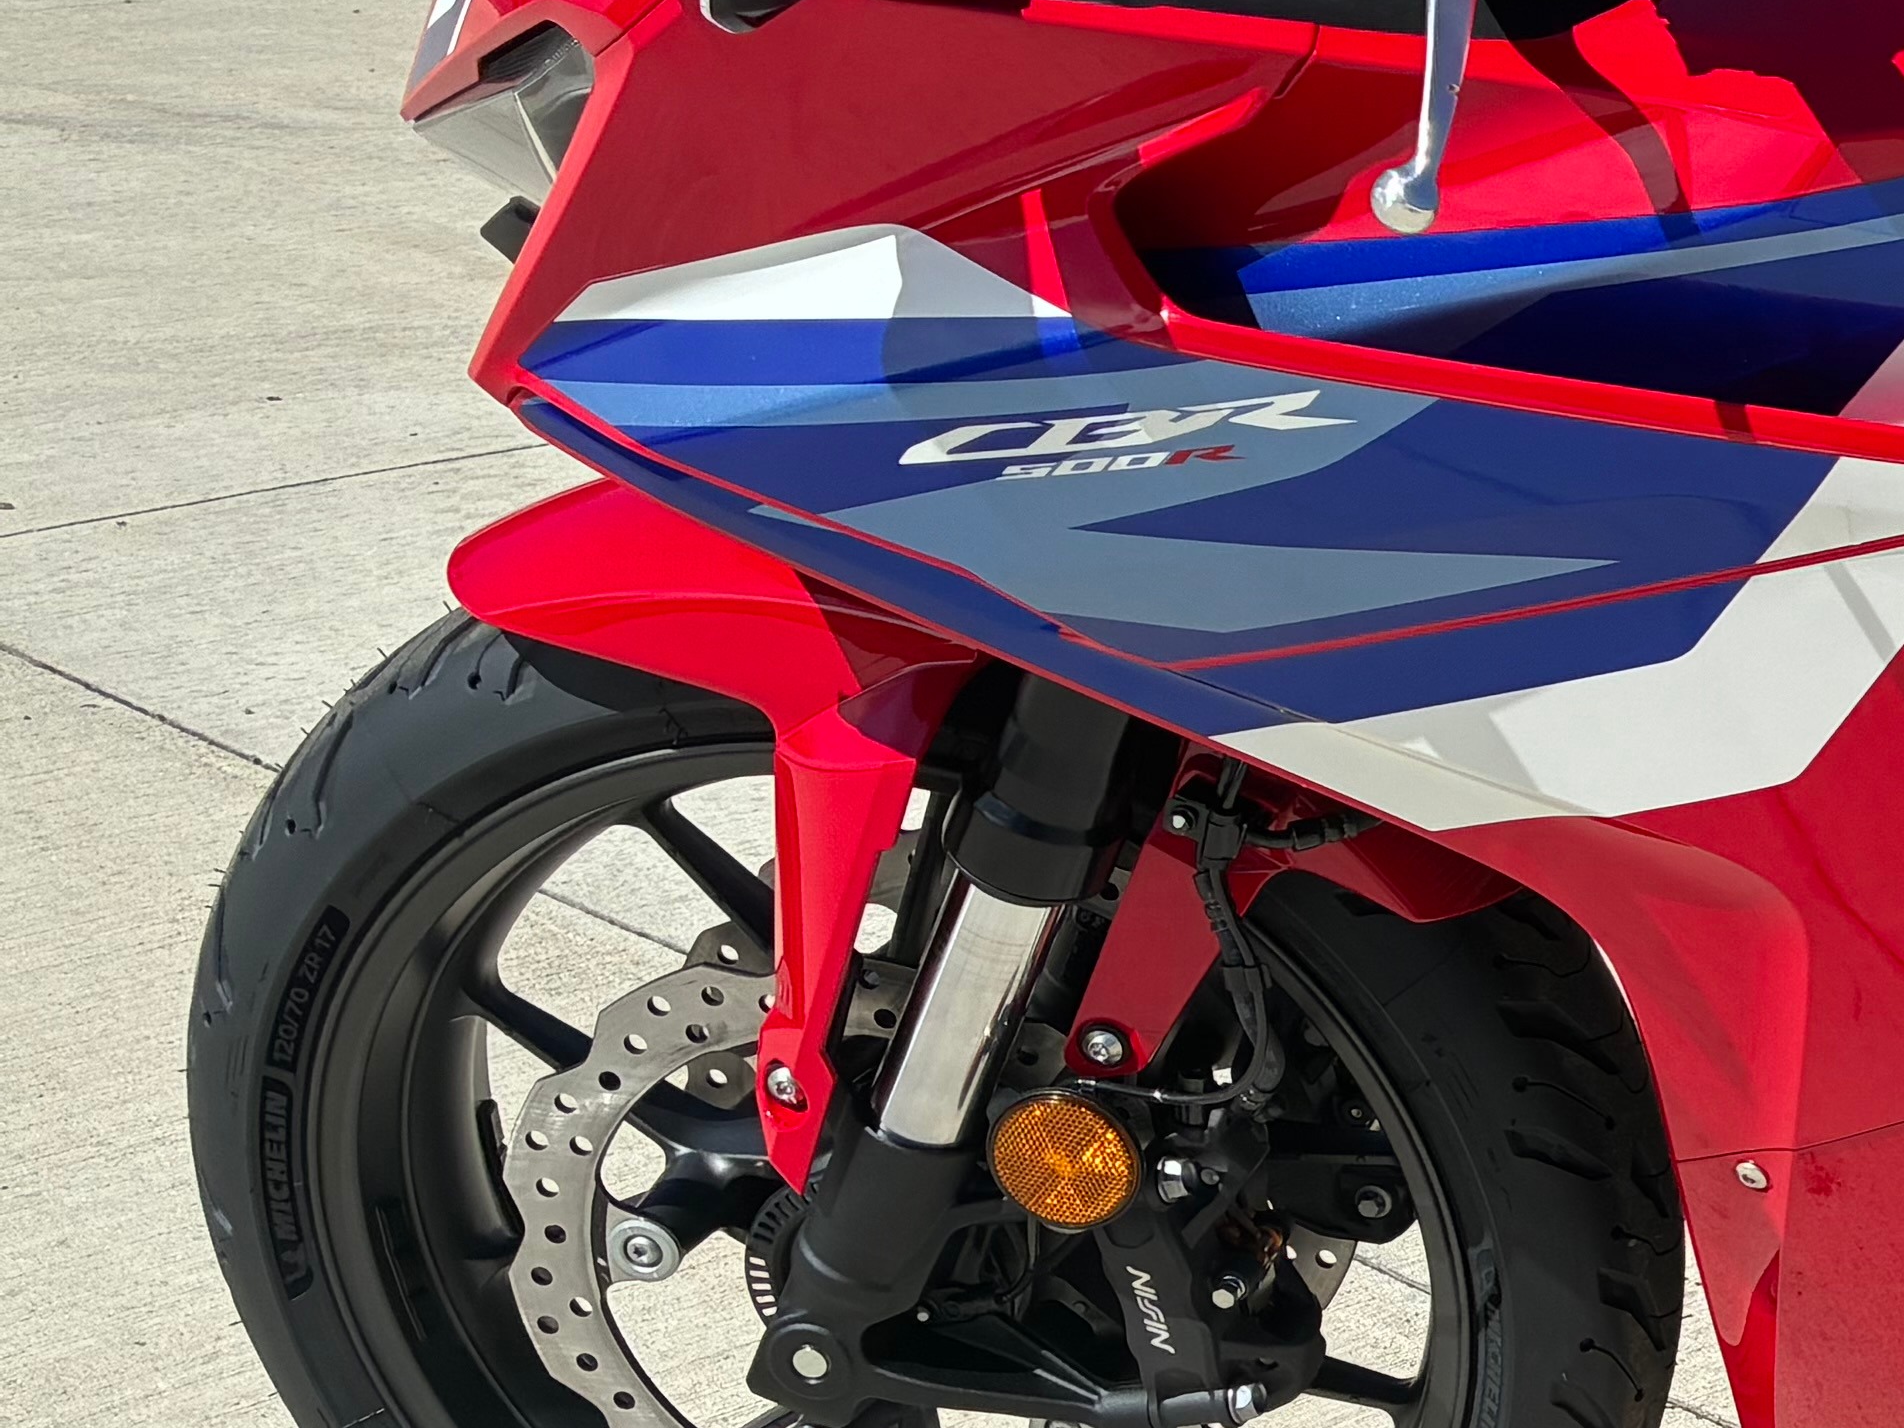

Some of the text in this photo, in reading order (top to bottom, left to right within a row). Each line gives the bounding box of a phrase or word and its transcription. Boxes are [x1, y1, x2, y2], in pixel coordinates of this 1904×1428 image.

[899, 389, 1358, 466] CBR
[996, 444, 1245, 481] 500R
[264, 924, 337, 1244] MICHELIN 120/70 ZR 17
